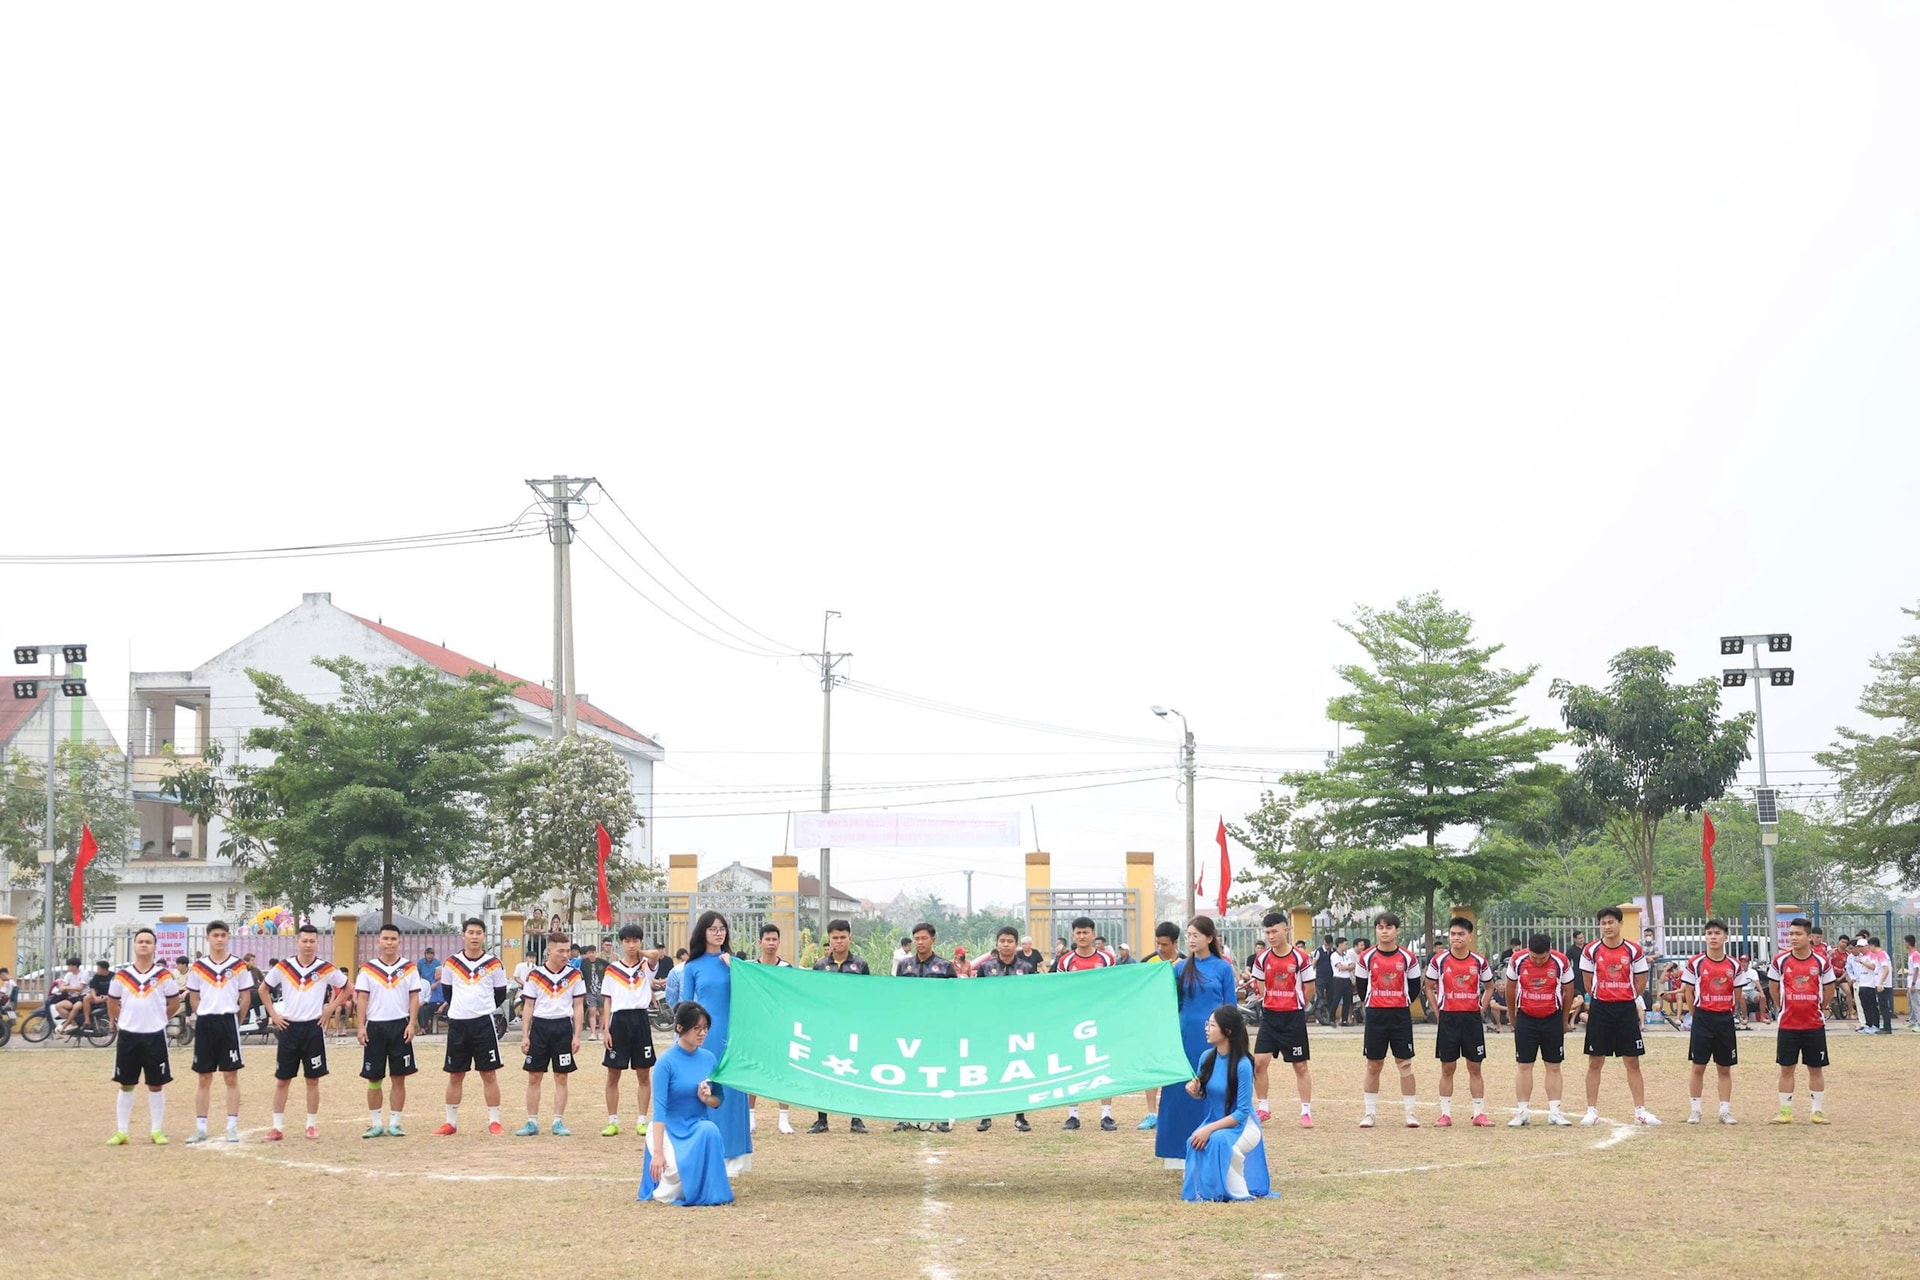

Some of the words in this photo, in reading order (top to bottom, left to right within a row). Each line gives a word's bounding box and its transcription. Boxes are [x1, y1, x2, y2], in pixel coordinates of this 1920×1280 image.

[794, 1020, 1098, 1058] LIVING
[489, 1050, 496, 1062] 3
[1292, 1046, 1302, 1056] 28
[1820, 1052, 1824, 1060] 7
[160, 1062, 166, 1074] 7
[1028, 1075, 1115, 1104] FIFA
